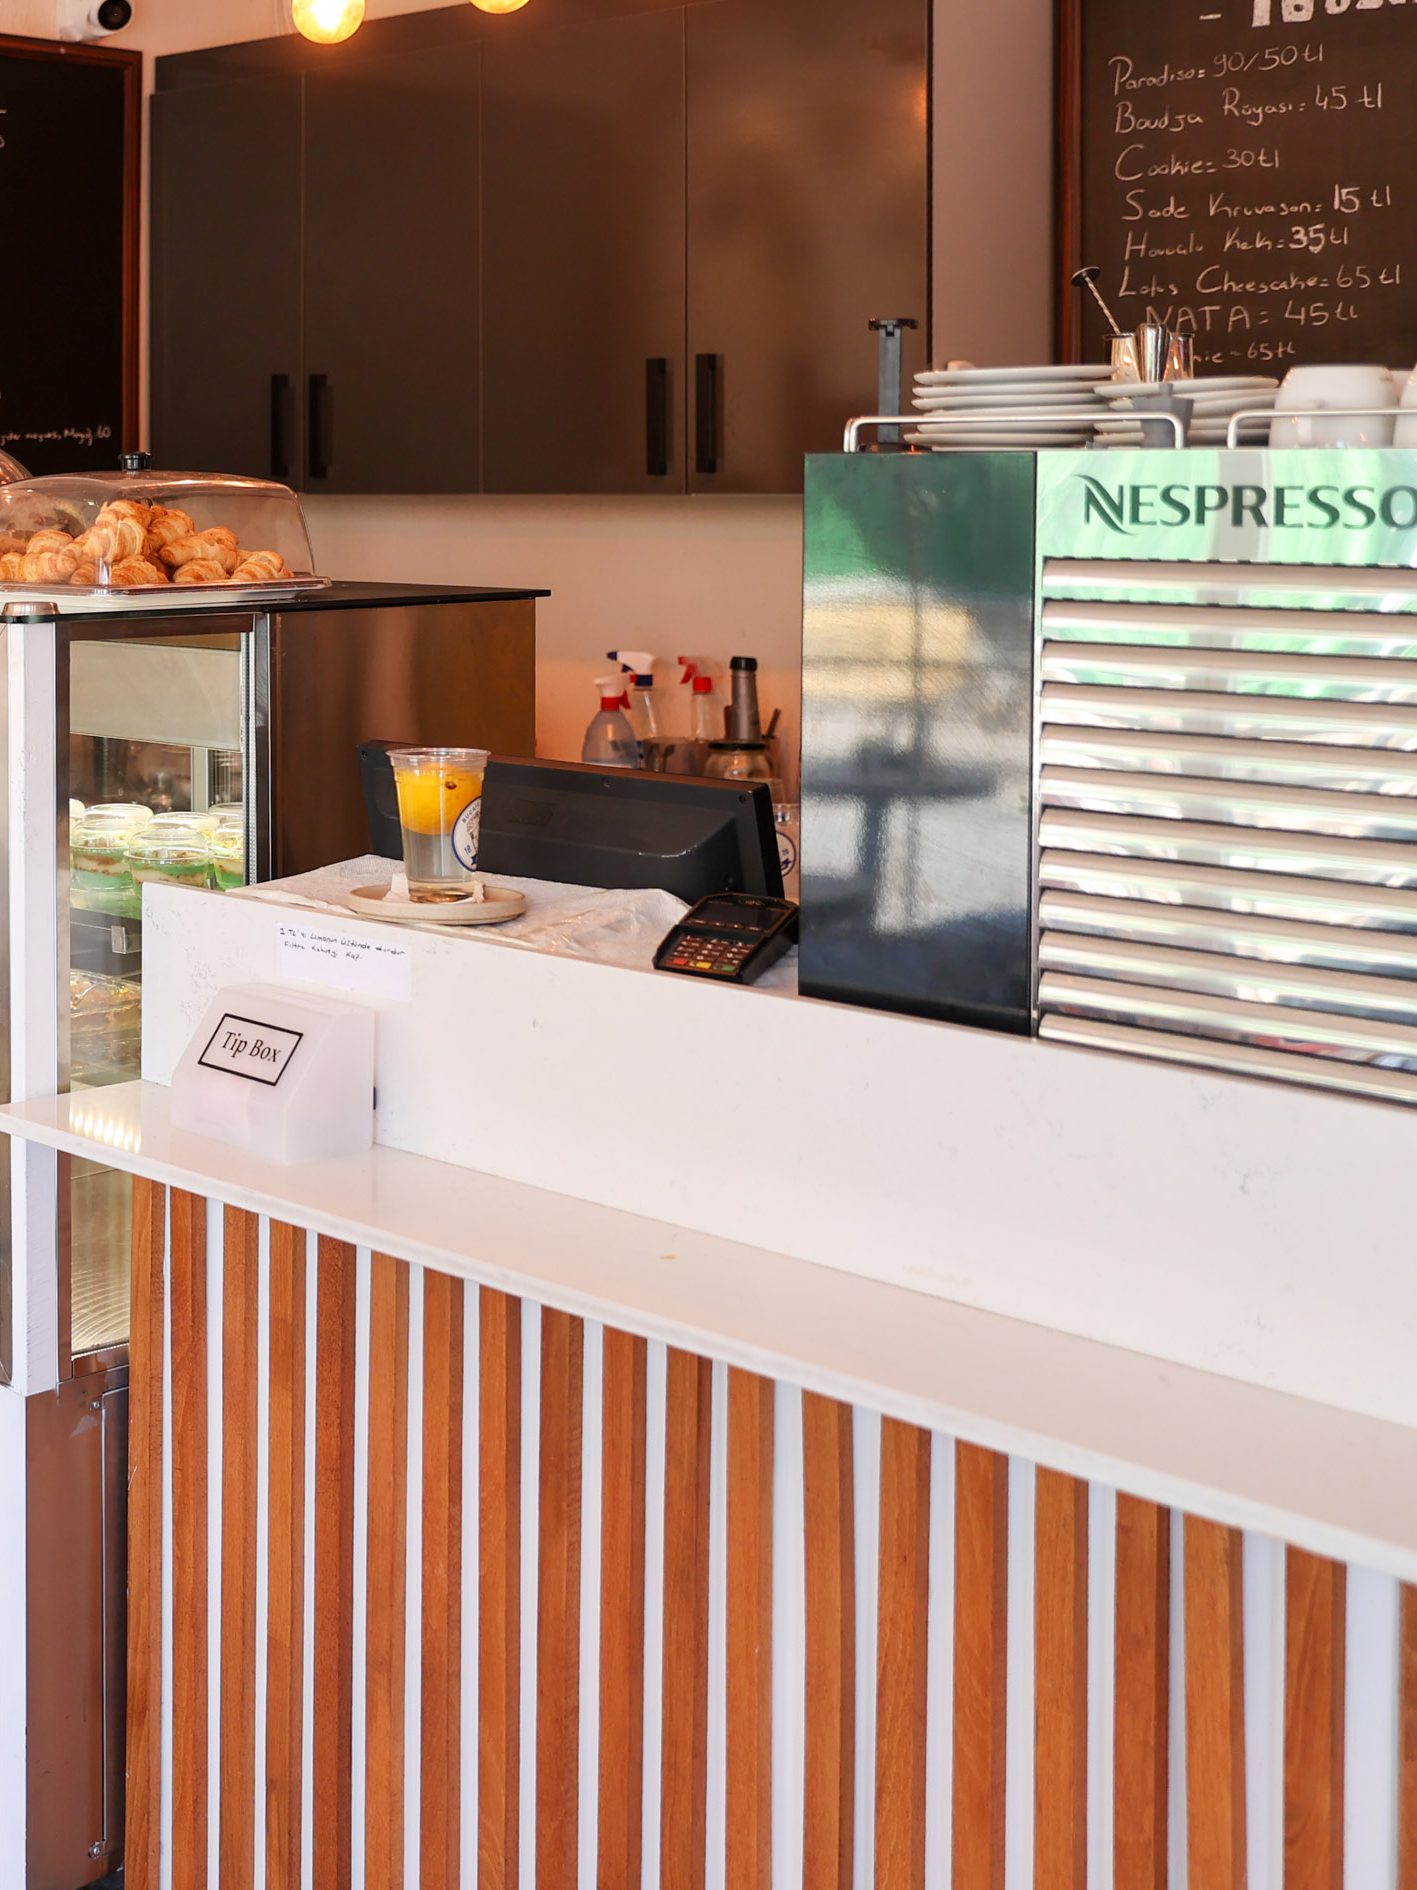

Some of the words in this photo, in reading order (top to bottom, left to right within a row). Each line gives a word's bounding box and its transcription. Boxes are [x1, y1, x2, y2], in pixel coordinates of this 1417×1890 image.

[1334, 184, 1360, 213] 15
[1070, 474, 1417, 534] NESPRESSO
[221, 1031, 248, 1058] Tip
[248, 1038, 281, 1063] Box
